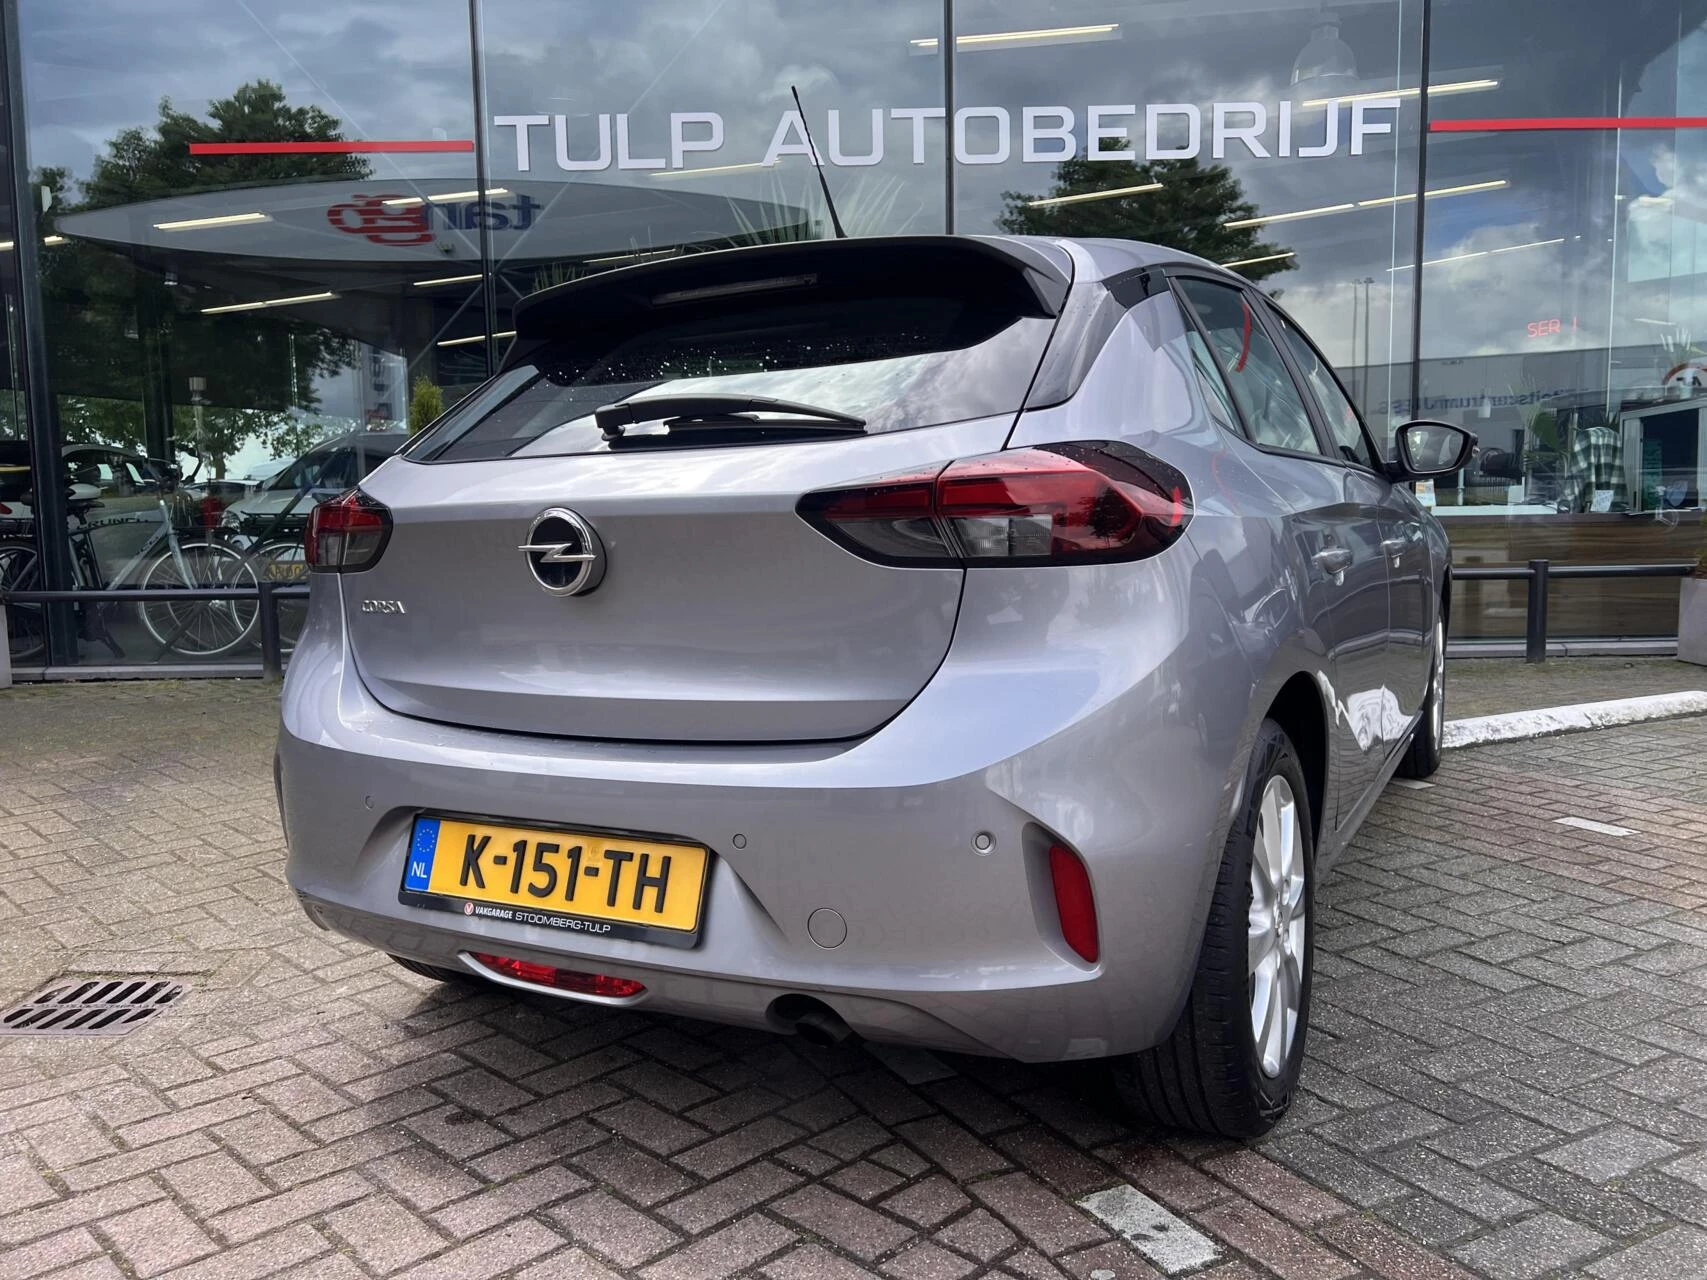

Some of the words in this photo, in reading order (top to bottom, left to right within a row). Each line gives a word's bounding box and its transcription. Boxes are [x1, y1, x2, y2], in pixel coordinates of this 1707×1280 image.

[494, 112, 726, 172] TULP
[762, 97, 1402, 167] AUTOBEDRIJF
[361, 599, 407, 614] CORSA
[411, 861, 428, 879] NL
[459, 834, 672, 914] K-151-TH
[474, 905, 513, 920] VAKGARAGE
[515, 911, 611, 933] STOOMBERG-TULP
